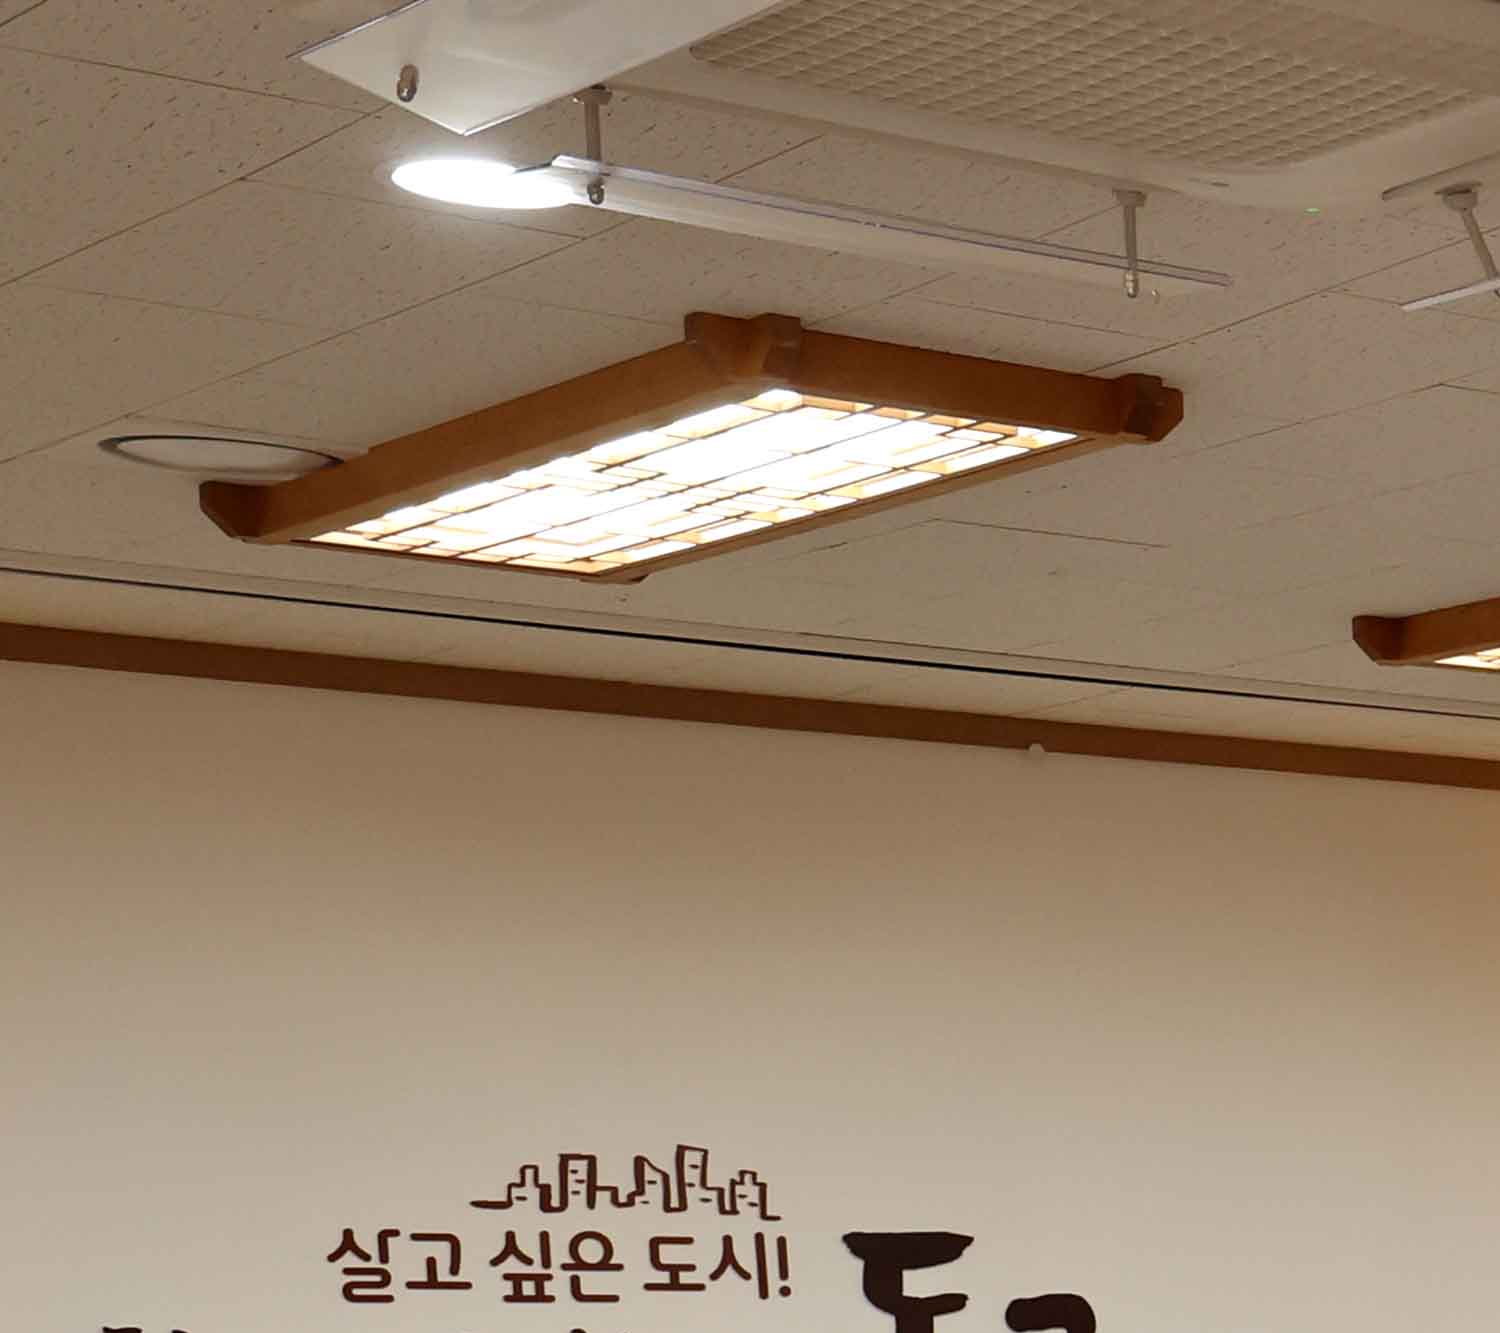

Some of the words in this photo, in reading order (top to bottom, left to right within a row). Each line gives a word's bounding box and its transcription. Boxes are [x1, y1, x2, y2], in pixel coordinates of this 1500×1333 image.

[326, 1227, 473, 1304] 살고
[489, 1230, 625, 1304] 싶은
[642, 1231, 792, 1301] 도시!
